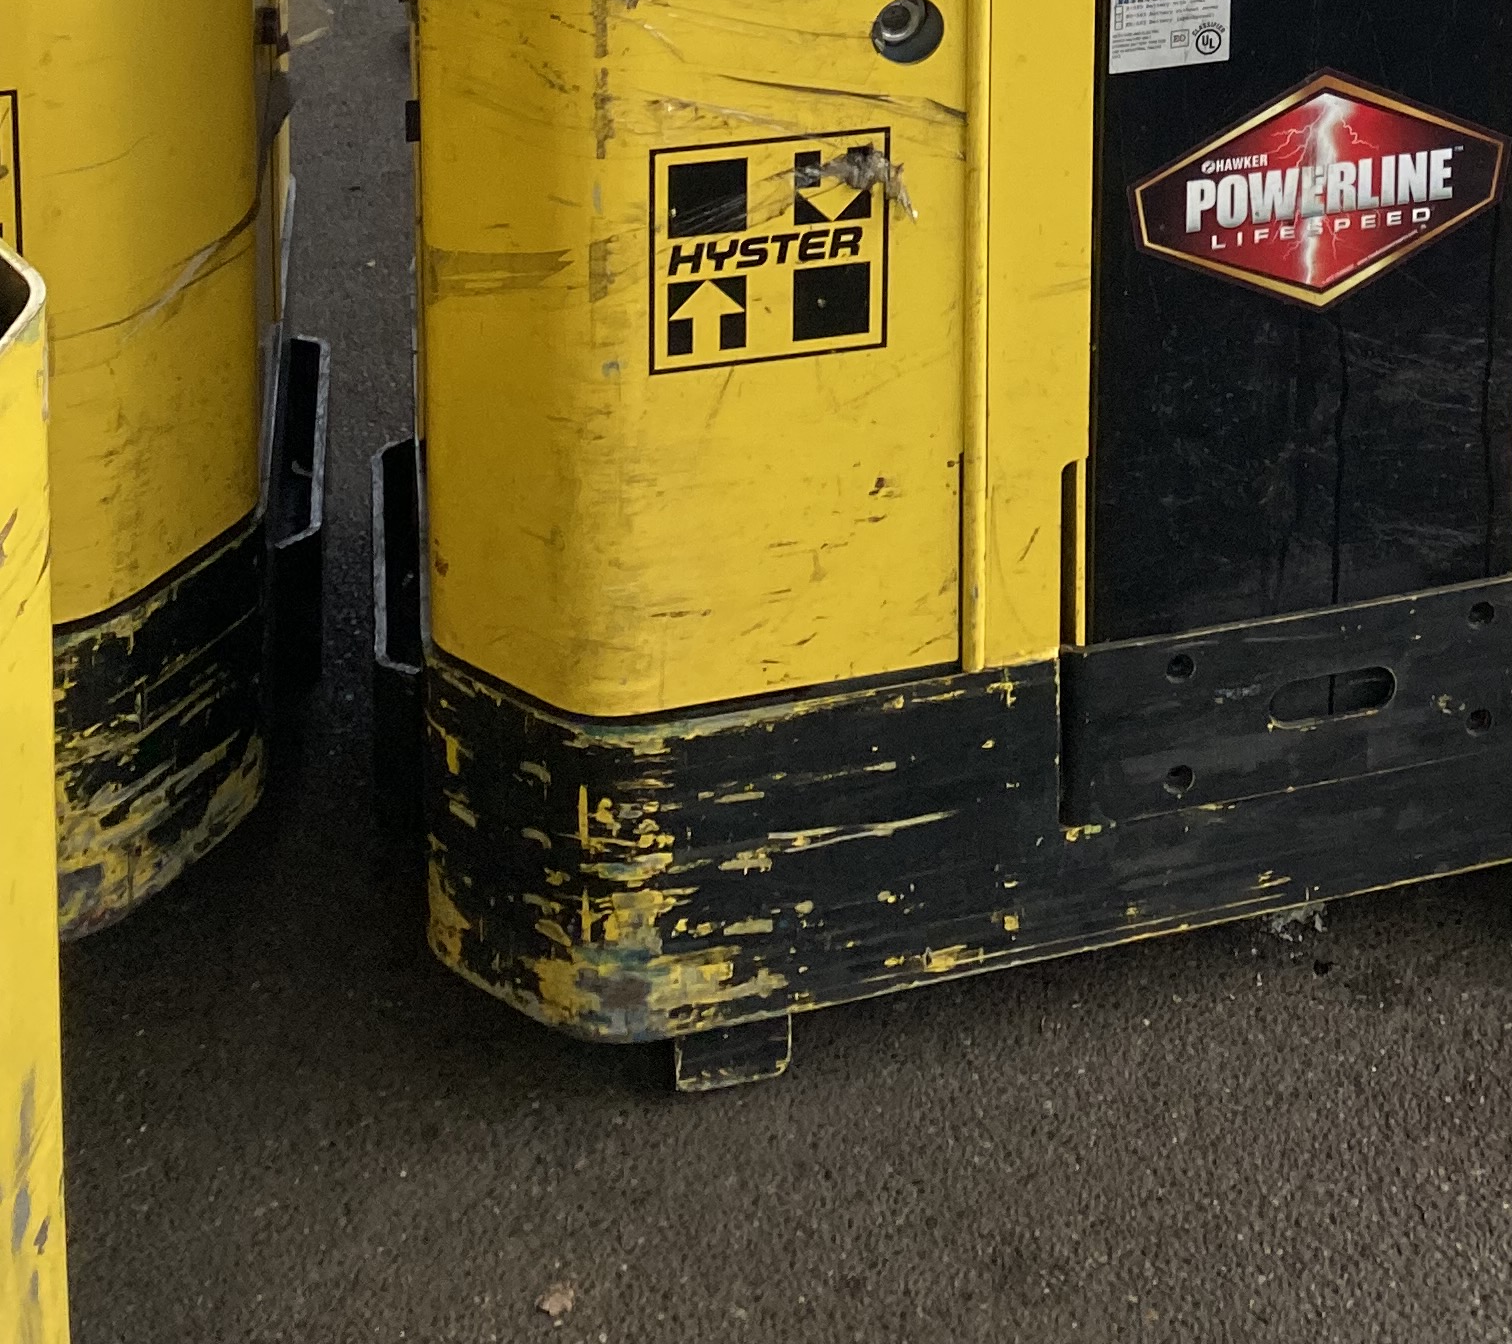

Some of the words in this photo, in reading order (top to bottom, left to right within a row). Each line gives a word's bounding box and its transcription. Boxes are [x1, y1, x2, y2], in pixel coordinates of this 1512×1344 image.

[1201, 34, 1215, 49] UL
[1215, 154, 1268, 173] HAWKER
[1185, 147, 1453, 234] POWERLINE
[667, 226, 863, 276] HYSTER
[1211, 207, 1431, 251] LIFESPEED
